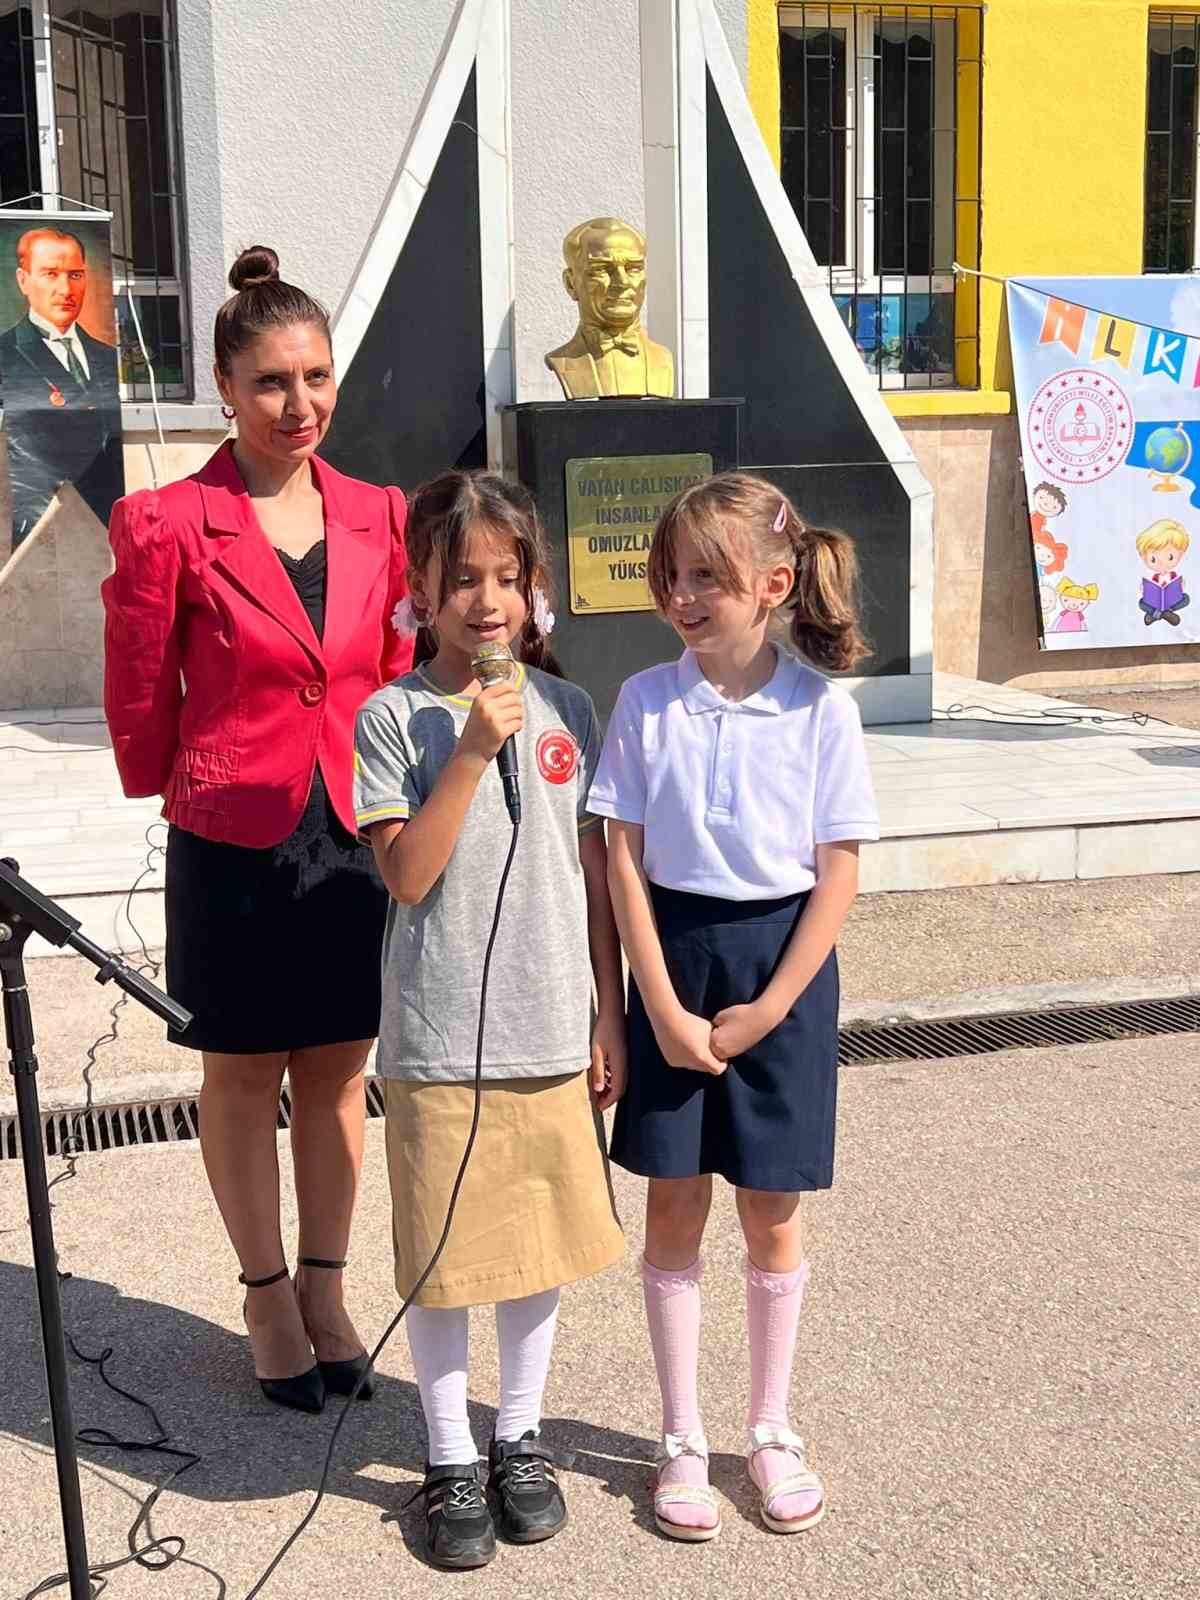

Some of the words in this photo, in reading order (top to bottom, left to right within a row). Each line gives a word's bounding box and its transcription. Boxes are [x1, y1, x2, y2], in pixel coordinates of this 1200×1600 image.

[1054, 304, 1181, 375] İLK
[577, 479, 625, 497] VATAN
[596, 504, 663, 525] İNSANLA
[588, 534, 651, 553] OMUZLA
[608, 560, 647, 581] YÜKS
